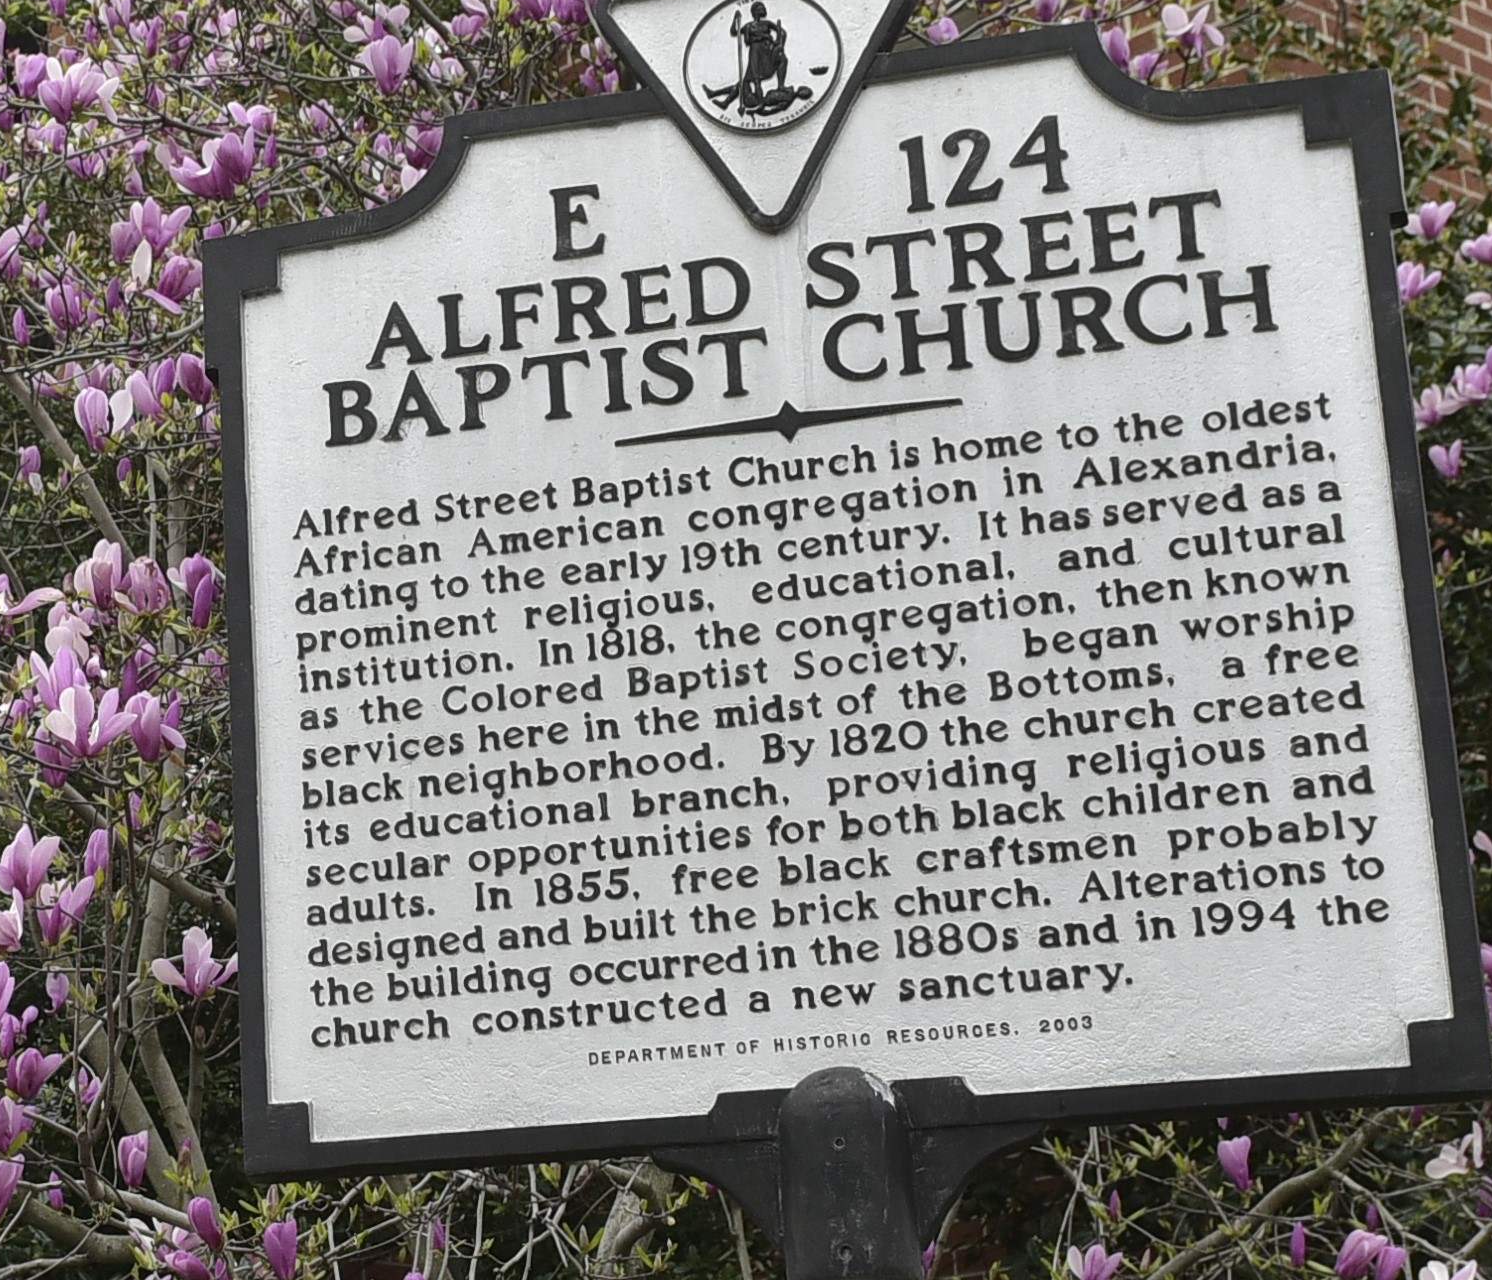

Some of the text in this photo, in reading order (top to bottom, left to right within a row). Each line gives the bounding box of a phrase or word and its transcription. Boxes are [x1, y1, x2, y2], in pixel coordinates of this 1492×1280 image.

[549, 115, 1071, 263] E 124
[365, 188, 1222, 371] ALFRED STREET
[322, 264, 1280, 448] BAPTIST CHURCH
[291, 391, 1332, 541] Alfred Street Baptist Church is home to the oldest
[292, 432, 1337, 579] African American congregation in Alexandria,
[293, 479, 1343, 617] dating to the early 19th century. It has served as a
[294, 512, 1347, 662] prominent religious, educational, and cultural
[297, 561, 1352, 695] institution. In 1818, the congregation, then known
[299, 595, 1356, 732] as the Colored Baptist Society, began worship
[300, 642, 1360, 772] services here in the midst of the Bottoms, a free
[301, 679, 1366, 811] black neighborhood. By 1820 the church created
[302, 722, 1370, 850] its educational branch, providing religious and
[305, 763, 1376, 889] secular opportunities for both black children and
[305, 809, 1379, 928] adults. In 1855, free black craftsmen probably
[306, 852, 1386, 971] designed and built the brick church. Alterations to
[308, 893, 1390, 1008] the building occurred in the 1880s and in 1994 the
[310, 961, 1134, 1049] church constructed a new sanctuary.
[588, 1042, 725, 1066] DEPARTMENT
[736, 1039, 759, 1055] OF
[1039, 1015, 1093, 1033] 2003
